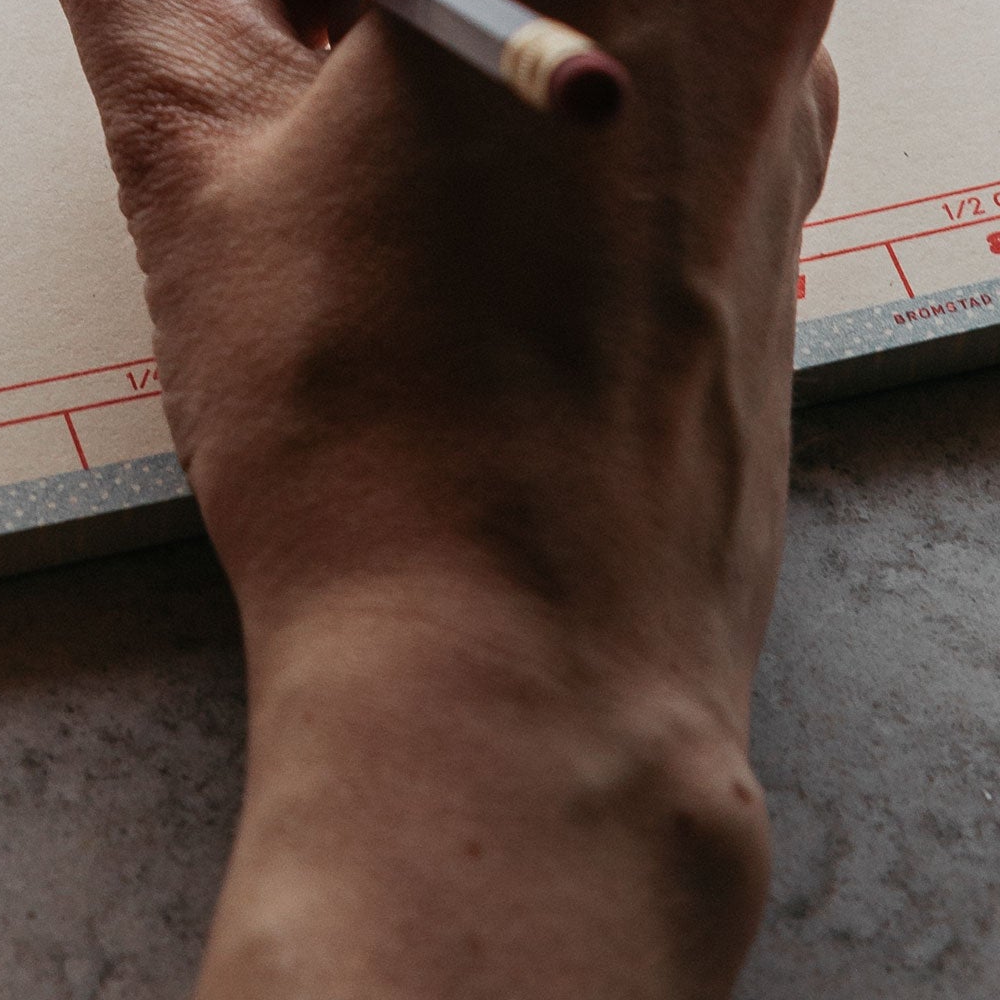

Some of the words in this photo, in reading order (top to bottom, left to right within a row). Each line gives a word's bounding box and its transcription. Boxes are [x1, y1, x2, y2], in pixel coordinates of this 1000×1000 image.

[941, 196, 986, 221] 1/2
[893, 293, 992, 325] BROMSTAD
[125, 367, 160, 391] 1/
